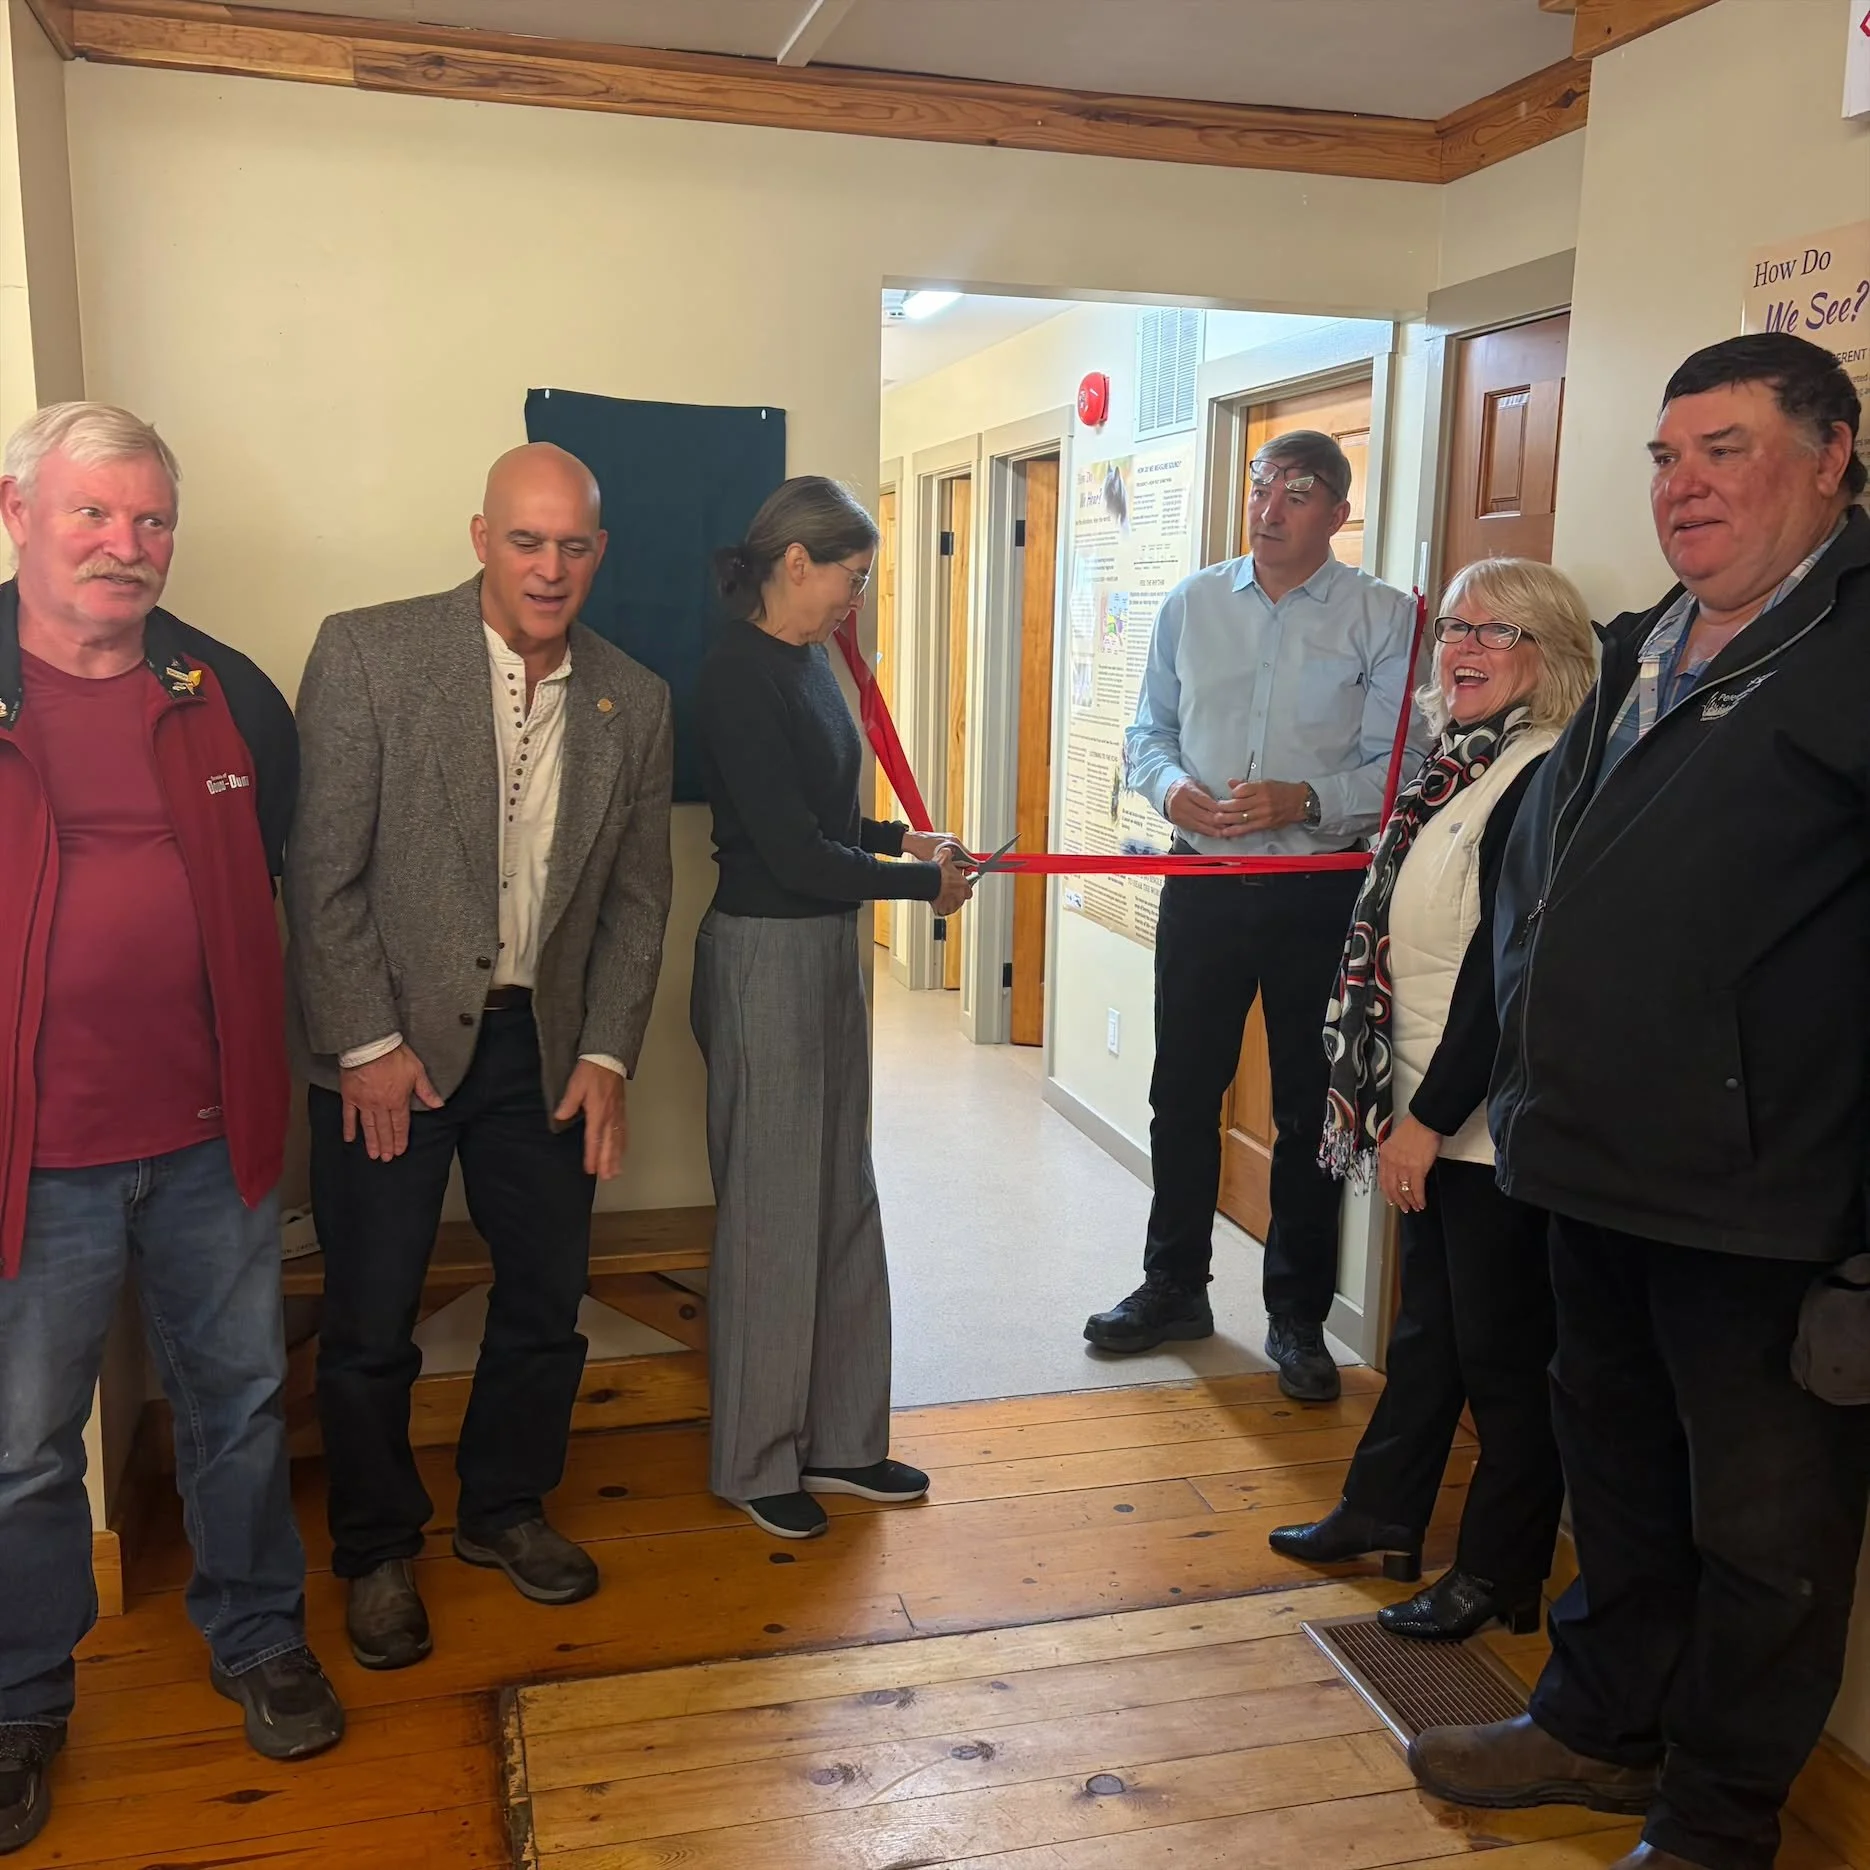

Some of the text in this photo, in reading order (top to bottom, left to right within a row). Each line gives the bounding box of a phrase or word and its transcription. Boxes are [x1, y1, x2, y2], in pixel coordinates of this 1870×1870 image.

[1753, 249, 1831, 288] How Do
[1766, 280, 1870, 334] We See?
[1832, 348, 1868, 363] ERENT
